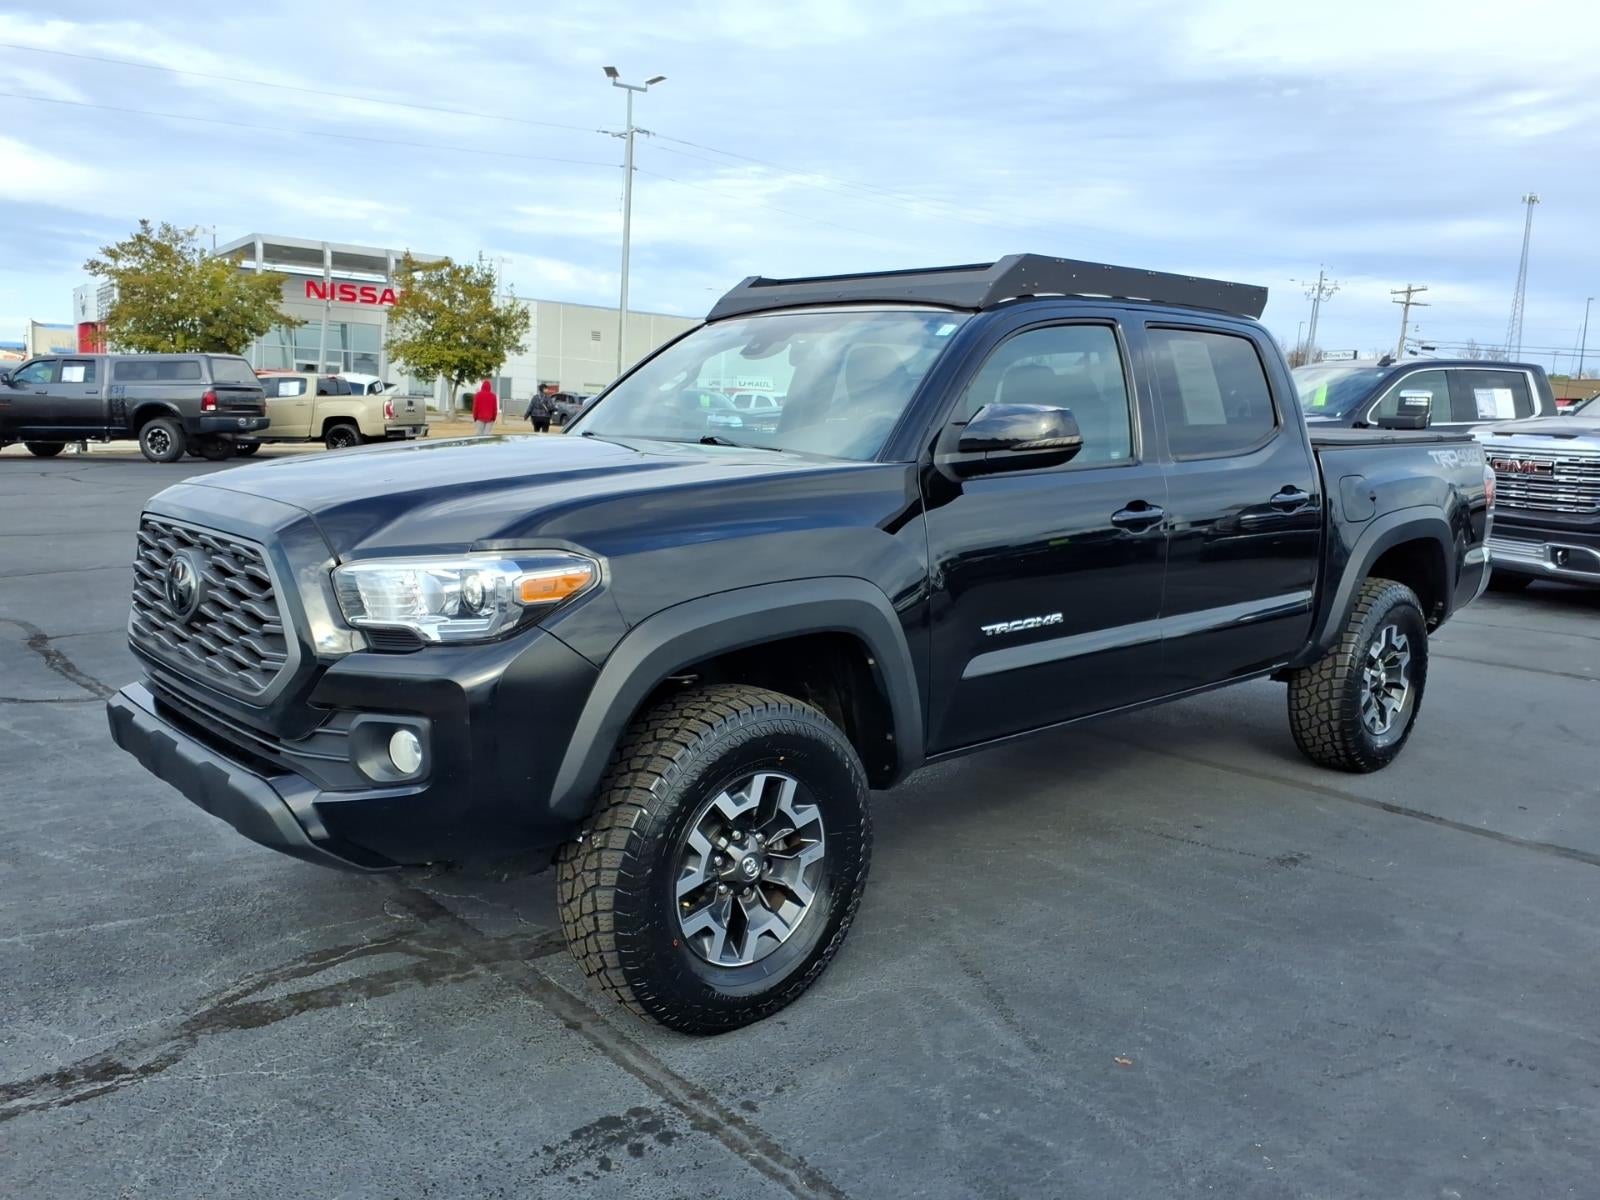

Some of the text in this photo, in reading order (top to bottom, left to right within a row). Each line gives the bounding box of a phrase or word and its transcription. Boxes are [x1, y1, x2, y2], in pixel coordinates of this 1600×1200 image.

[305, 280, 410, 305] NISSA
[1492, 458, 1552, 475] GMC
[981, 612, 1063, 636] TACOMA
